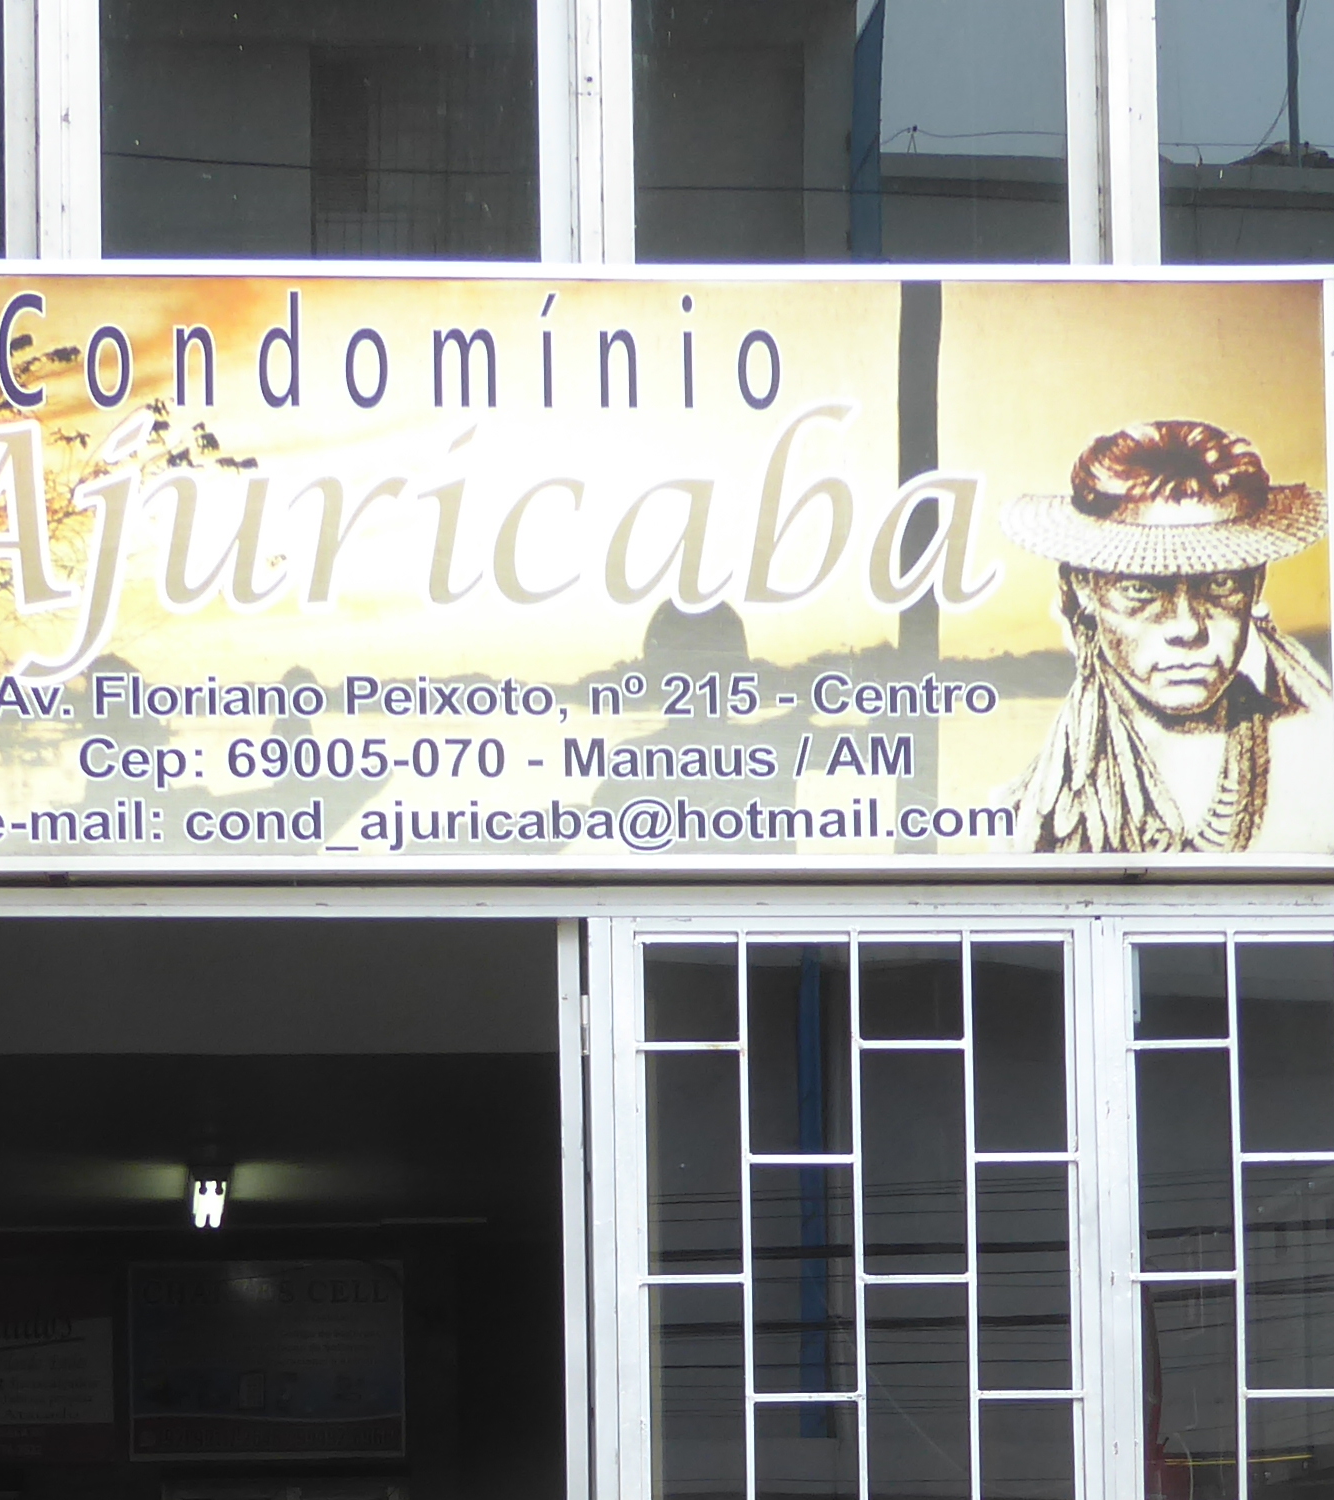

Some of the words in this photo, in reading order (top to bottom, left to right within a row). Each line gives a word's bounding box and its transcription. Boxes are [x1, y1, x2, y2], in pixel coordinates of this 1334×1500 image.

[95, 676, 324, 716] Floriano
[346, 676, 568, 723] Peixoto,
[664, 675, 758, 715] 215
[813, 674, 996, 715] Centro
[79, 738, 204, 788] Cep:
[228, 738, 505, 778] 69005-070
[564, 738, 776, 778] Manaus
[827, 736, 913, 776] AM
[186, 798, 1015, 851] cond_ajuricaba@hotmail.com
